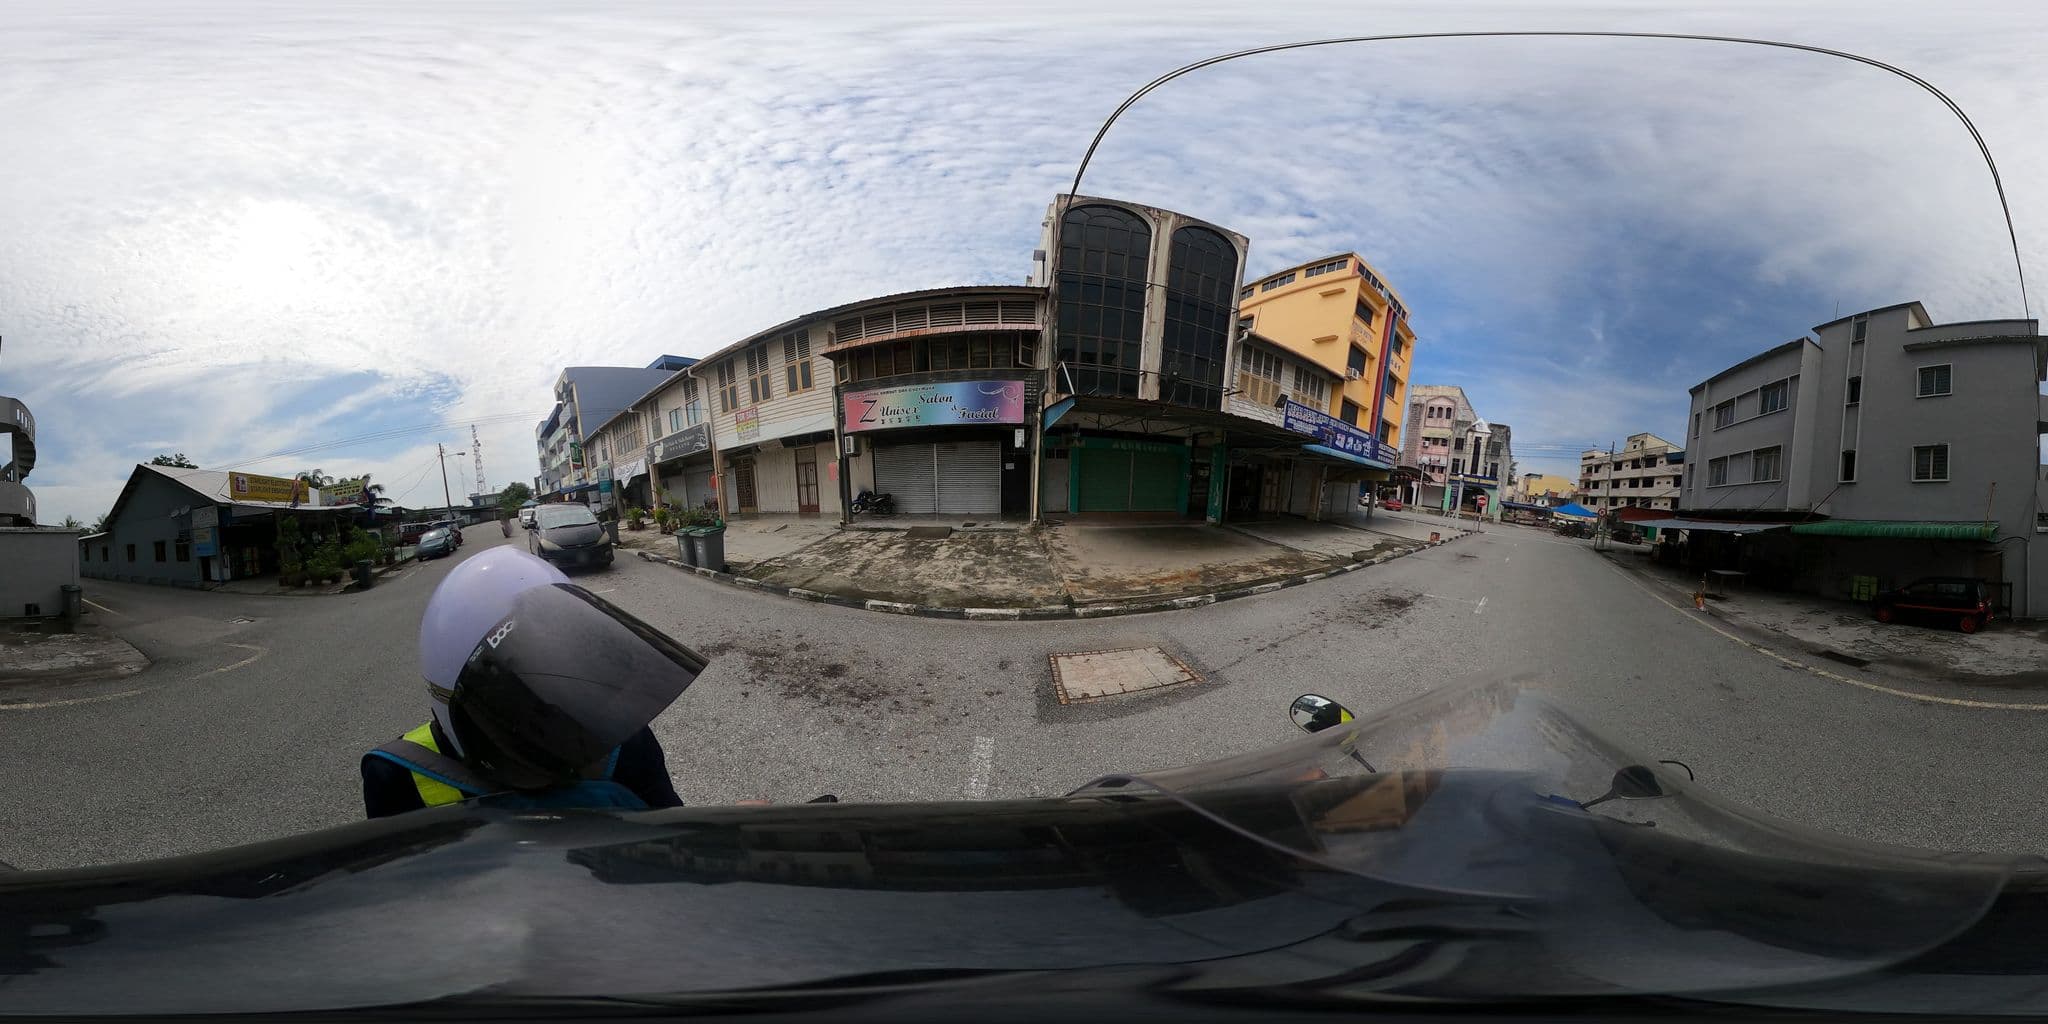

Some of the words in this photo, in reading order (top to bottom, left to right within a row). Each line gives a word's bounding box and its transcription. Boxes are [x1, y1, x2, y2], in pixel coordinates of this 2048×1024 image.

[918, 392, 953, 404] Salon
[860, 399, 878, 423] Z
[880, 405, 919, 417] Unisex
[958, 406, 999, 419] Facial
